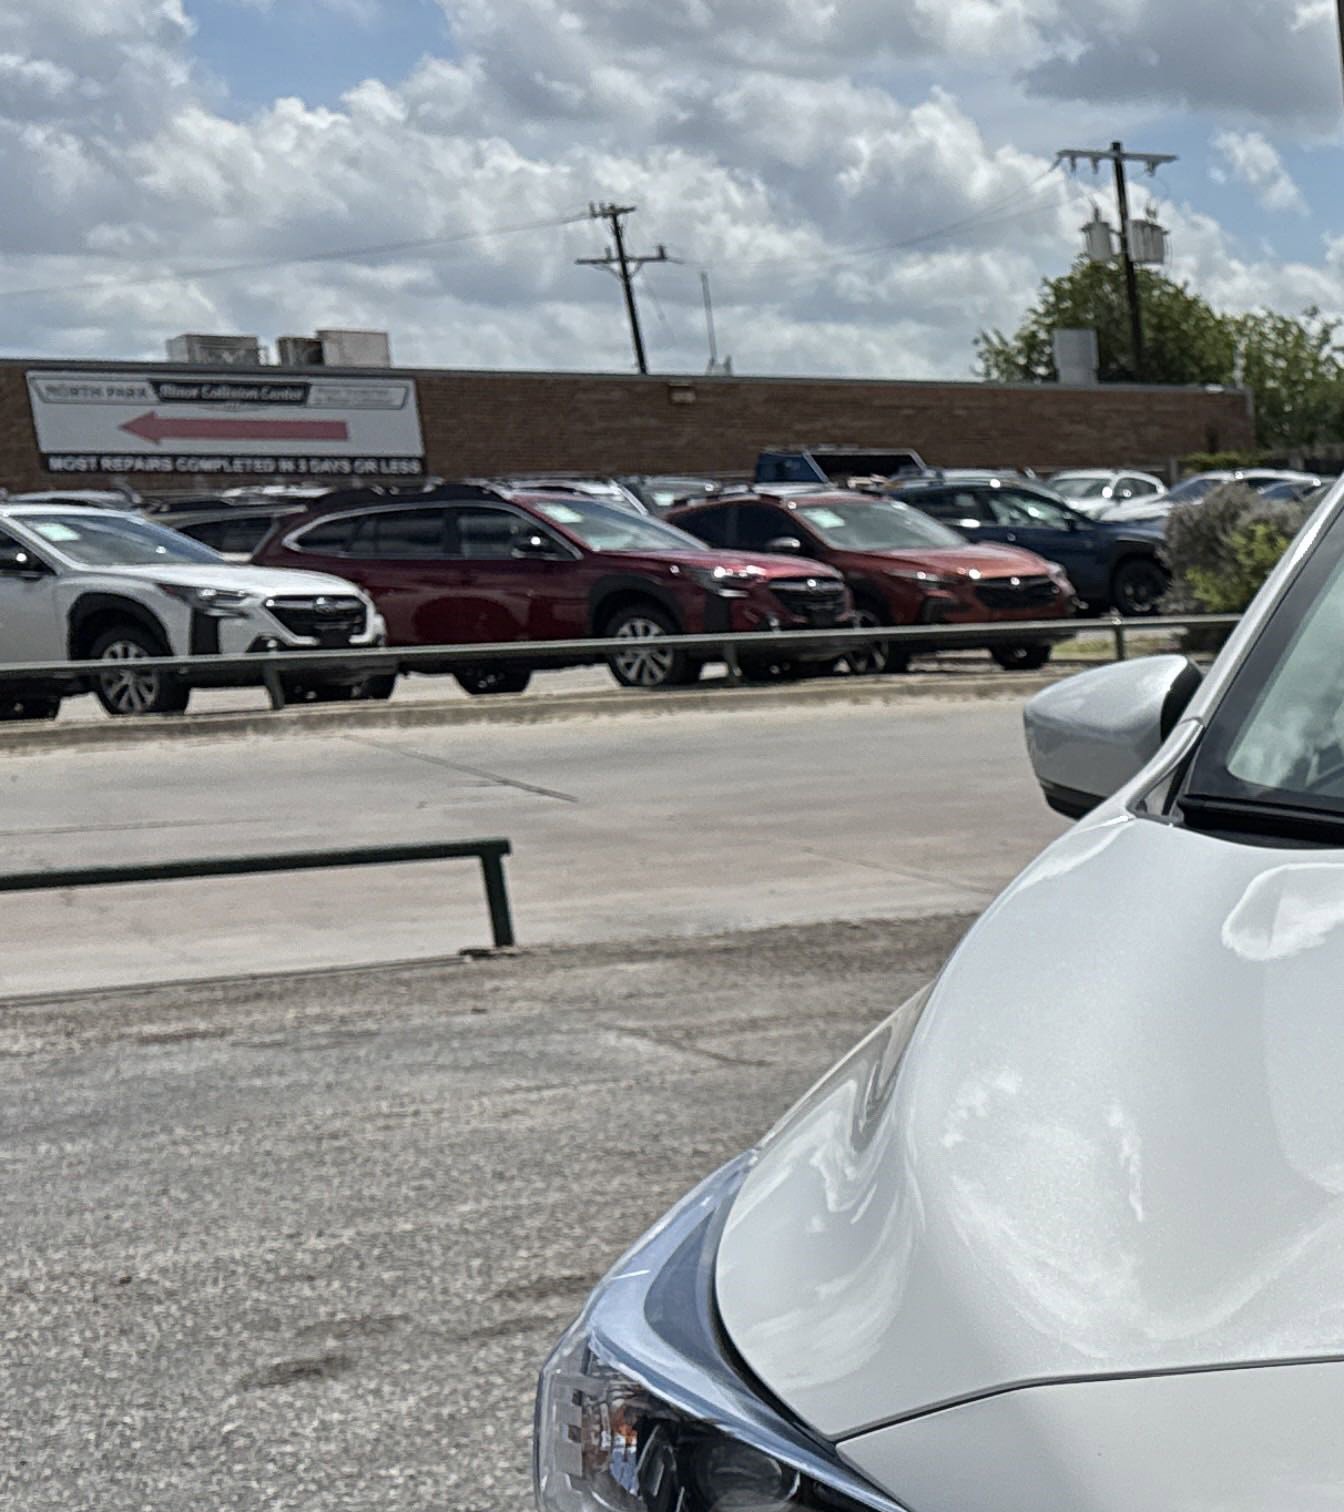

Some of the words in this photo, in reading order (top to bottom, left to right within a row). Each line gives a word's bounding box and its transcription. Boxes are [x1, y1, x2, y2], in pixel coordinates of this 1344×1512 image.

[49, 456, 98, 472] MOST
[101, 456, 174, 472] REPAIRS
[175, 457, 276, 473] COMPLETED
[278, 458, 297, 473] IN
[309, 458, 352, 473] DAYS
[353, 459, 378, 474] OR
[380, 459, 421, 474] LESS
